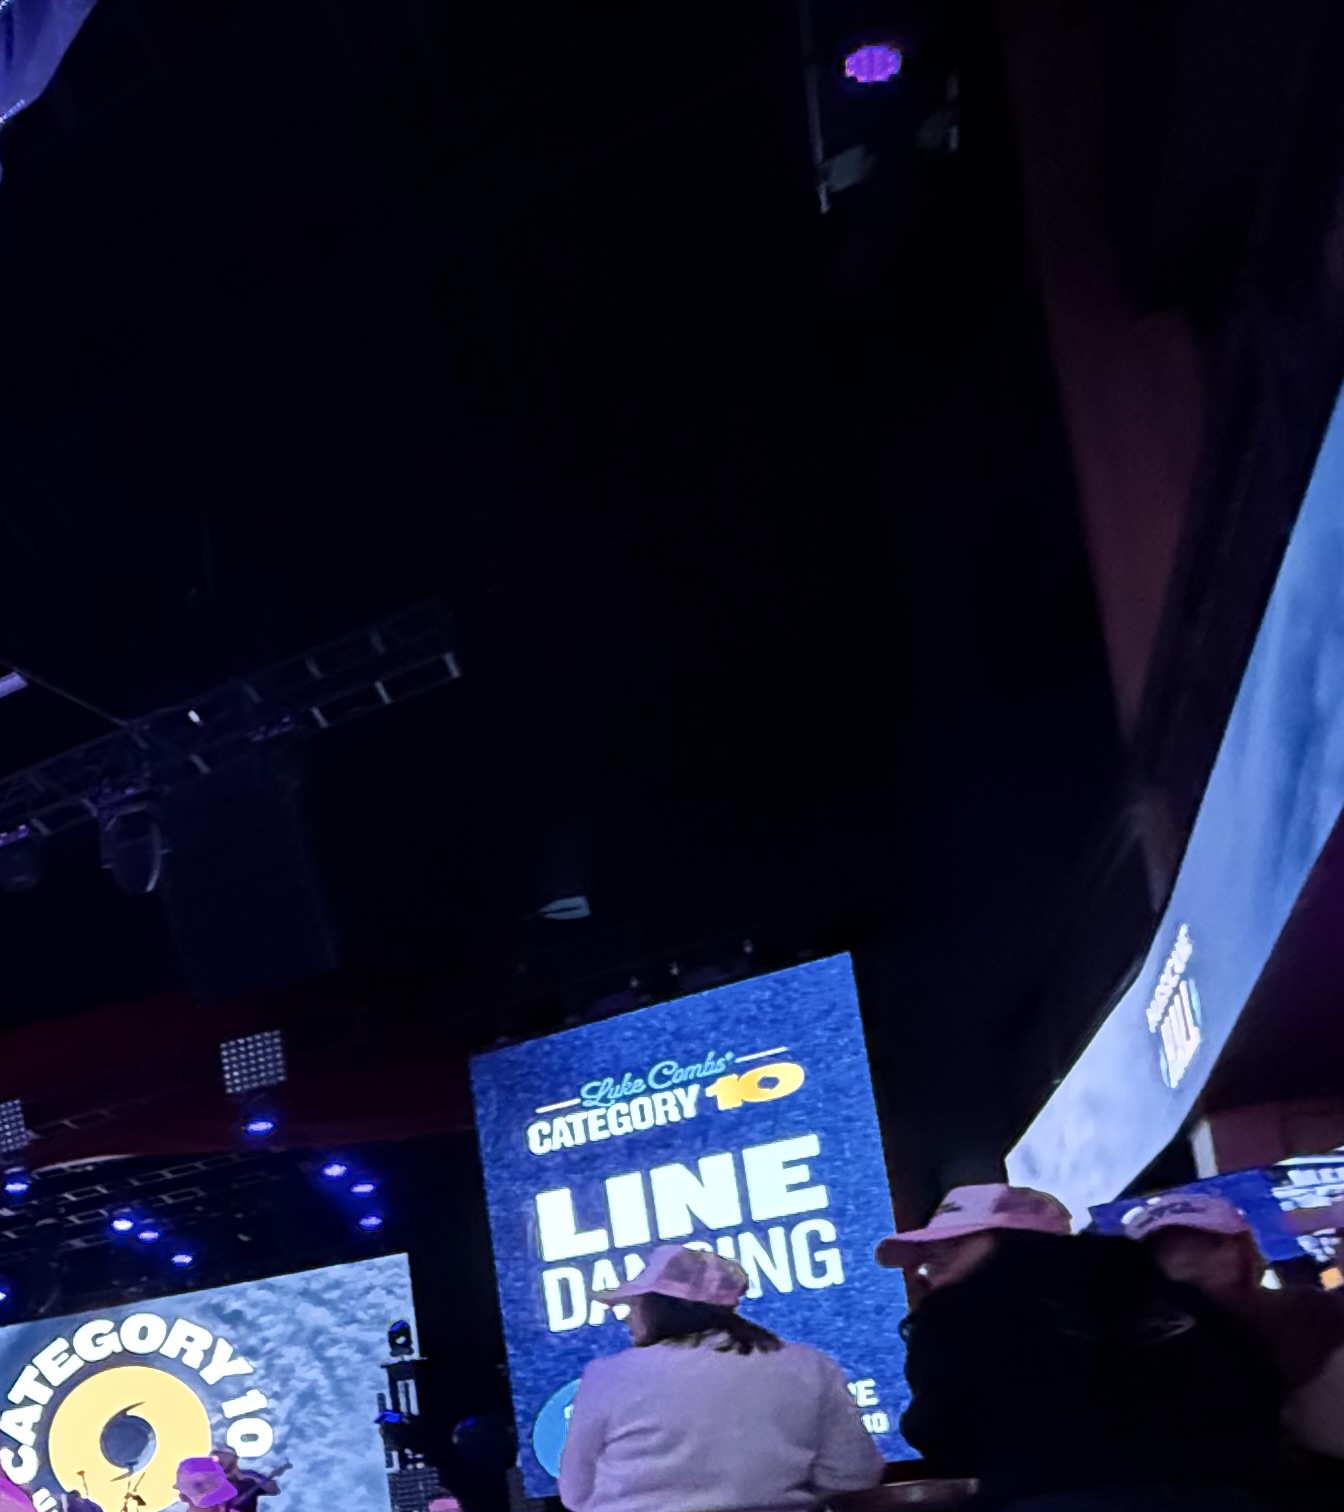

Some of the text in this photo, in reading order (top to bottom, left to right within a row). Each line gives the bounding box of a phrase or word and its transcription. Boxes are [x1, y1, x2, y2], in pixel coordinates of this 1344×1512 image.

[527, 1062, 805, 1155] CATEGORY 10
[580, 1072, 646, 1107] Luke
[535, 1133, 829, 1262] LINE
[541, 1218, 845, 1333] DANG
[0, 1312, 273, 1485] CATEGORY 10
